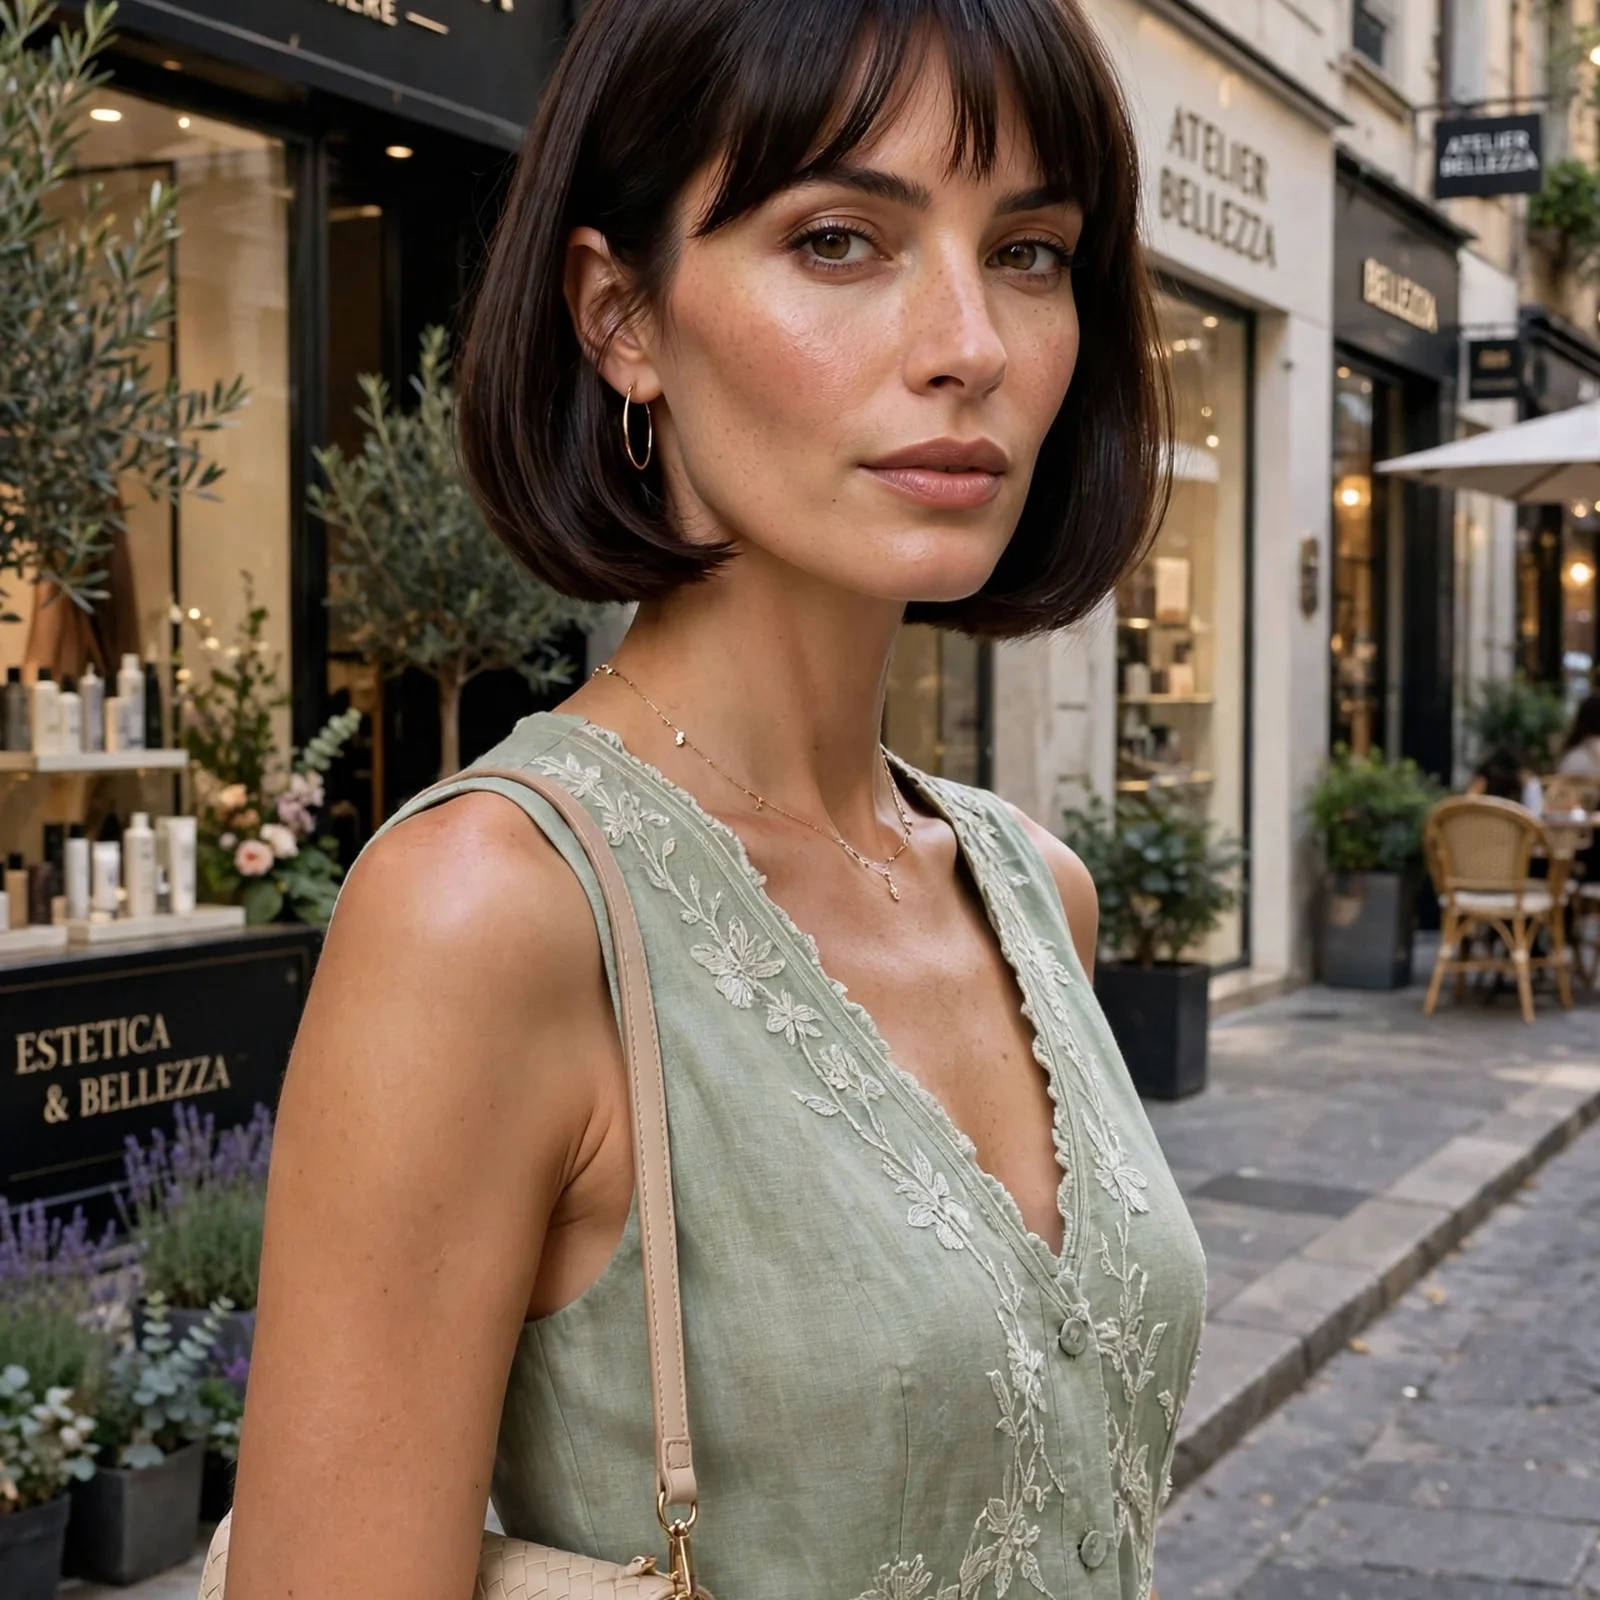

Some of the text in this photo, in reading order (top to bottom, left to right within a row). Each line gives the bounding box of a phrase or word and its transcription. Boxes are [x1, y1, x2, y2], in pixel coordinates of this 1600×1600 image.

[1168, 104, 1268, 202] ATELIER
[1439, 151, 1540, 178] BELLEZZA
[1445, 130, 1530, 155] ATELIER
[1159, 166, 1277, 269] BELLEZZA
[16, 1013, 171, 1075] ESTETICA
[43, 1054, 231, 1124] & BELLEZZA
